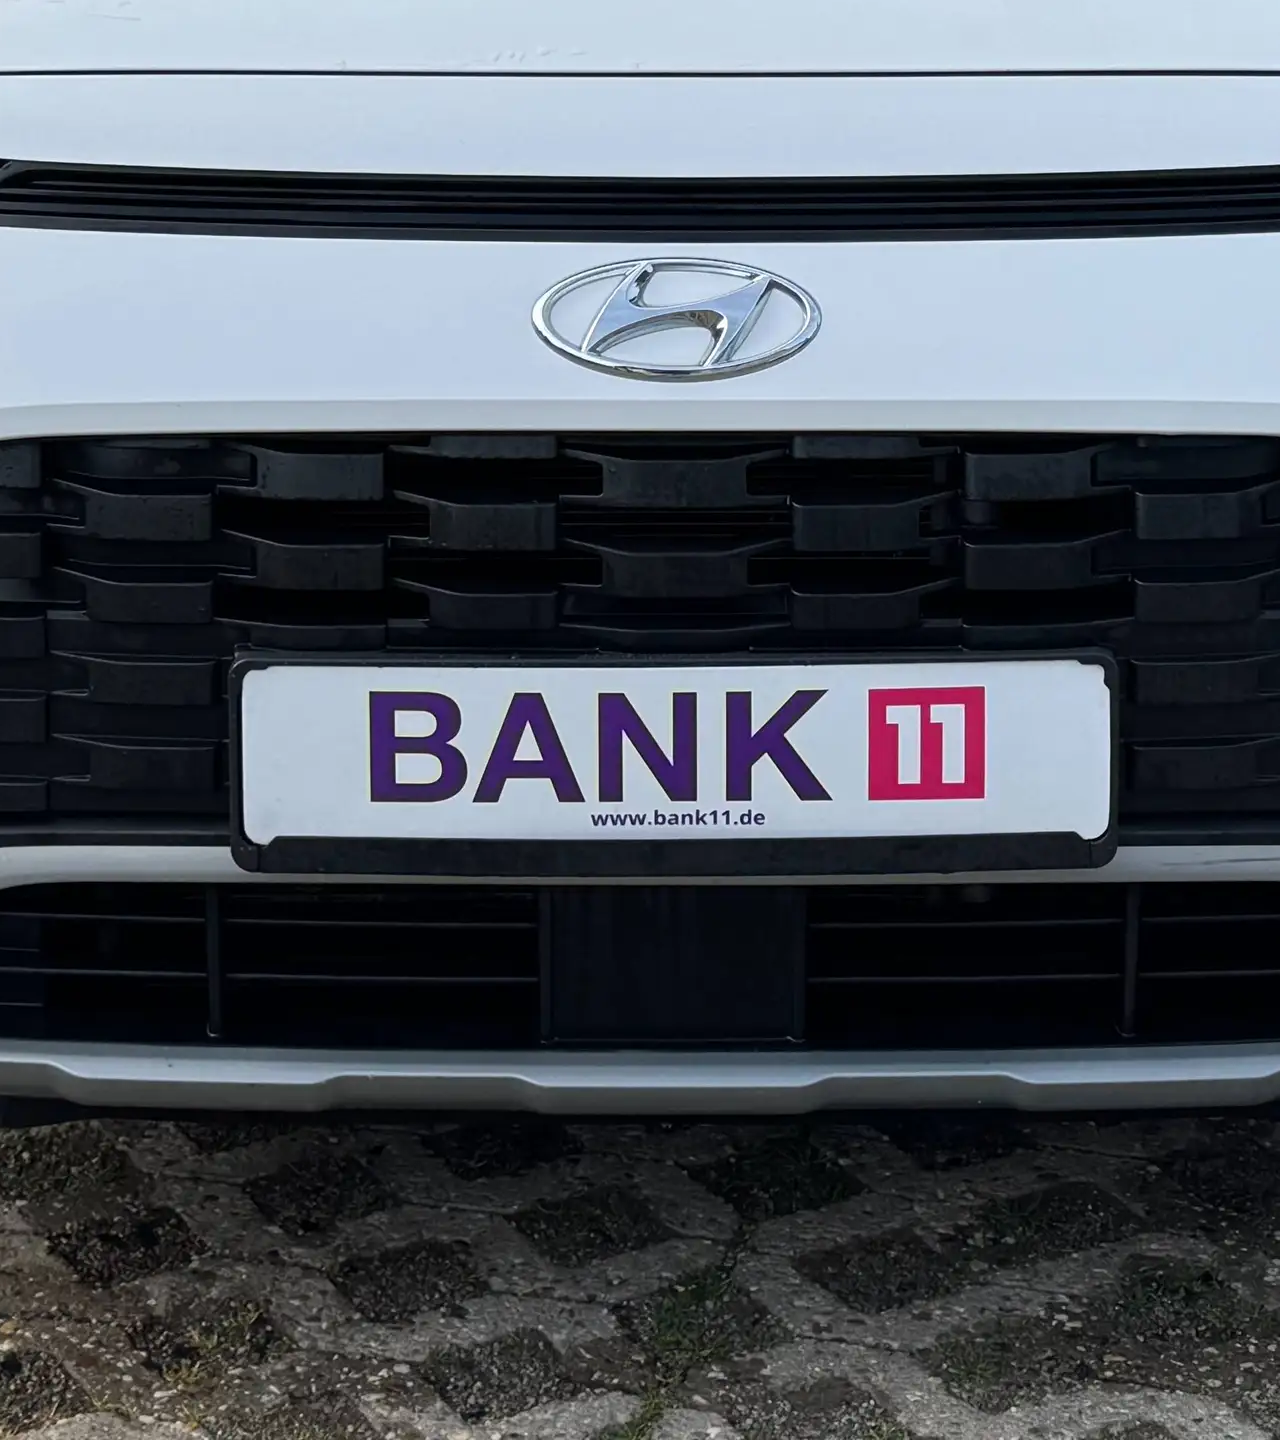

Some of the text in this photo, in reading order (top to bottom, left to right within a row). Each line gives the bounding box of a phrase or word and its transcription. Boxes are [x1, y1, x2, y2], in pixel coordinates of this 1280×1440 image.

[368, 689, 971, 803] BANK 11
[590, 809, 766, 827] www.bank11.de
